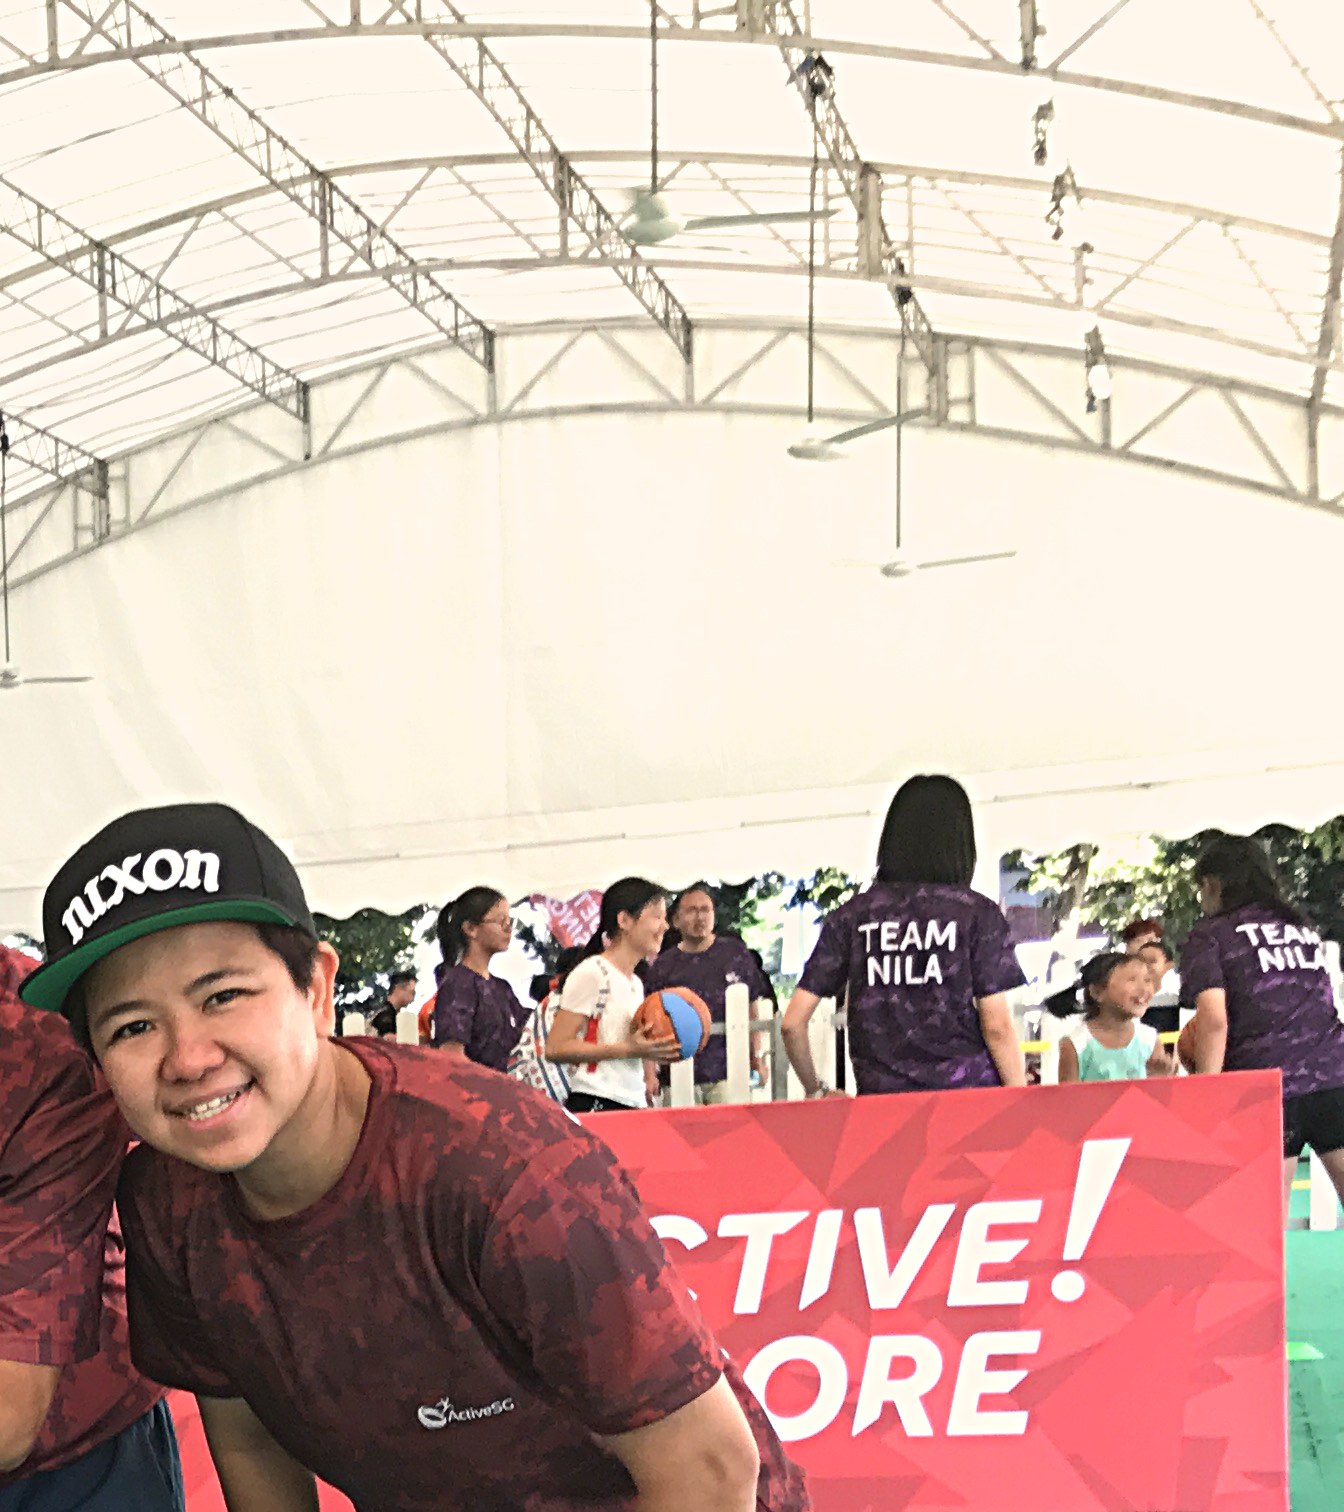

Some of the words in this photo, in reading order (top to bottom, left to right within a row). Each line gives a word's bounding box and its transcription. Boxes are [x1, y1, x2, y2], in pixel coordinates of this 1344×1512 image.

[62, 848, 221, 945] nixon
[858, 919, 957, 953] TEAM
[867, 953, 943, 987] NILA
[722, 1331, 1041, 1441] ORE
[448, 1397, 515, 1422] ActiveSG
